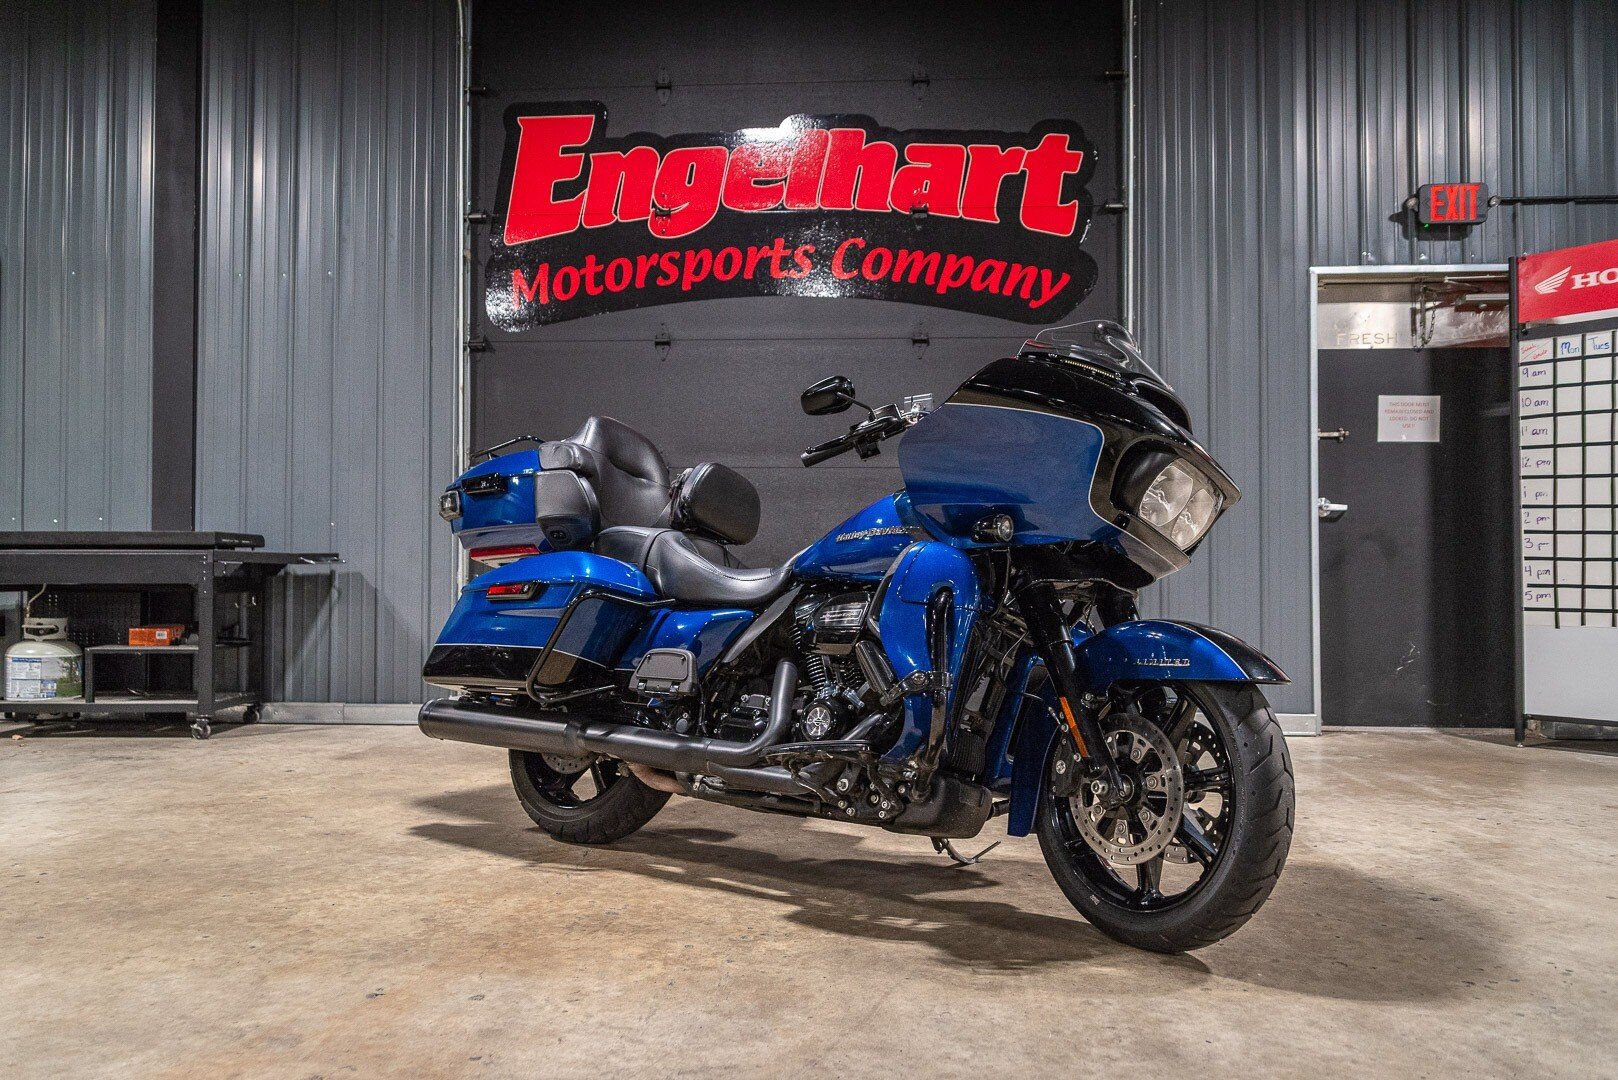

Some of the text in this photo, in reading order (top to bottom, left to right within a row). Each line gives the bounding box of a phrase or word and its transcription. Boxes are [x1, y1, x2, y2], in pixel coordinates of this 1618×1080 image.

[504, 115, 1083, 245] Engelhart
[1430, 184, 1480, 221] EXIT
[511, 237, 1071, 309] Motorsports Company
[1336, 332, 1398, 346] FRESH
[1561, 336, 1610, 355] Mon Tues
[1522, 367, 1547, 378] 9 am
[1521, 397, 1531, 407] 10
[1532, 428, 1549, 436] am
[1536, 460, 1551, 468] pm
[1524, 538, 1534, 549] 3
[1524, 565, 1551, 579] 4 pm
[1524, 591, 1552, 602] 5 pm
